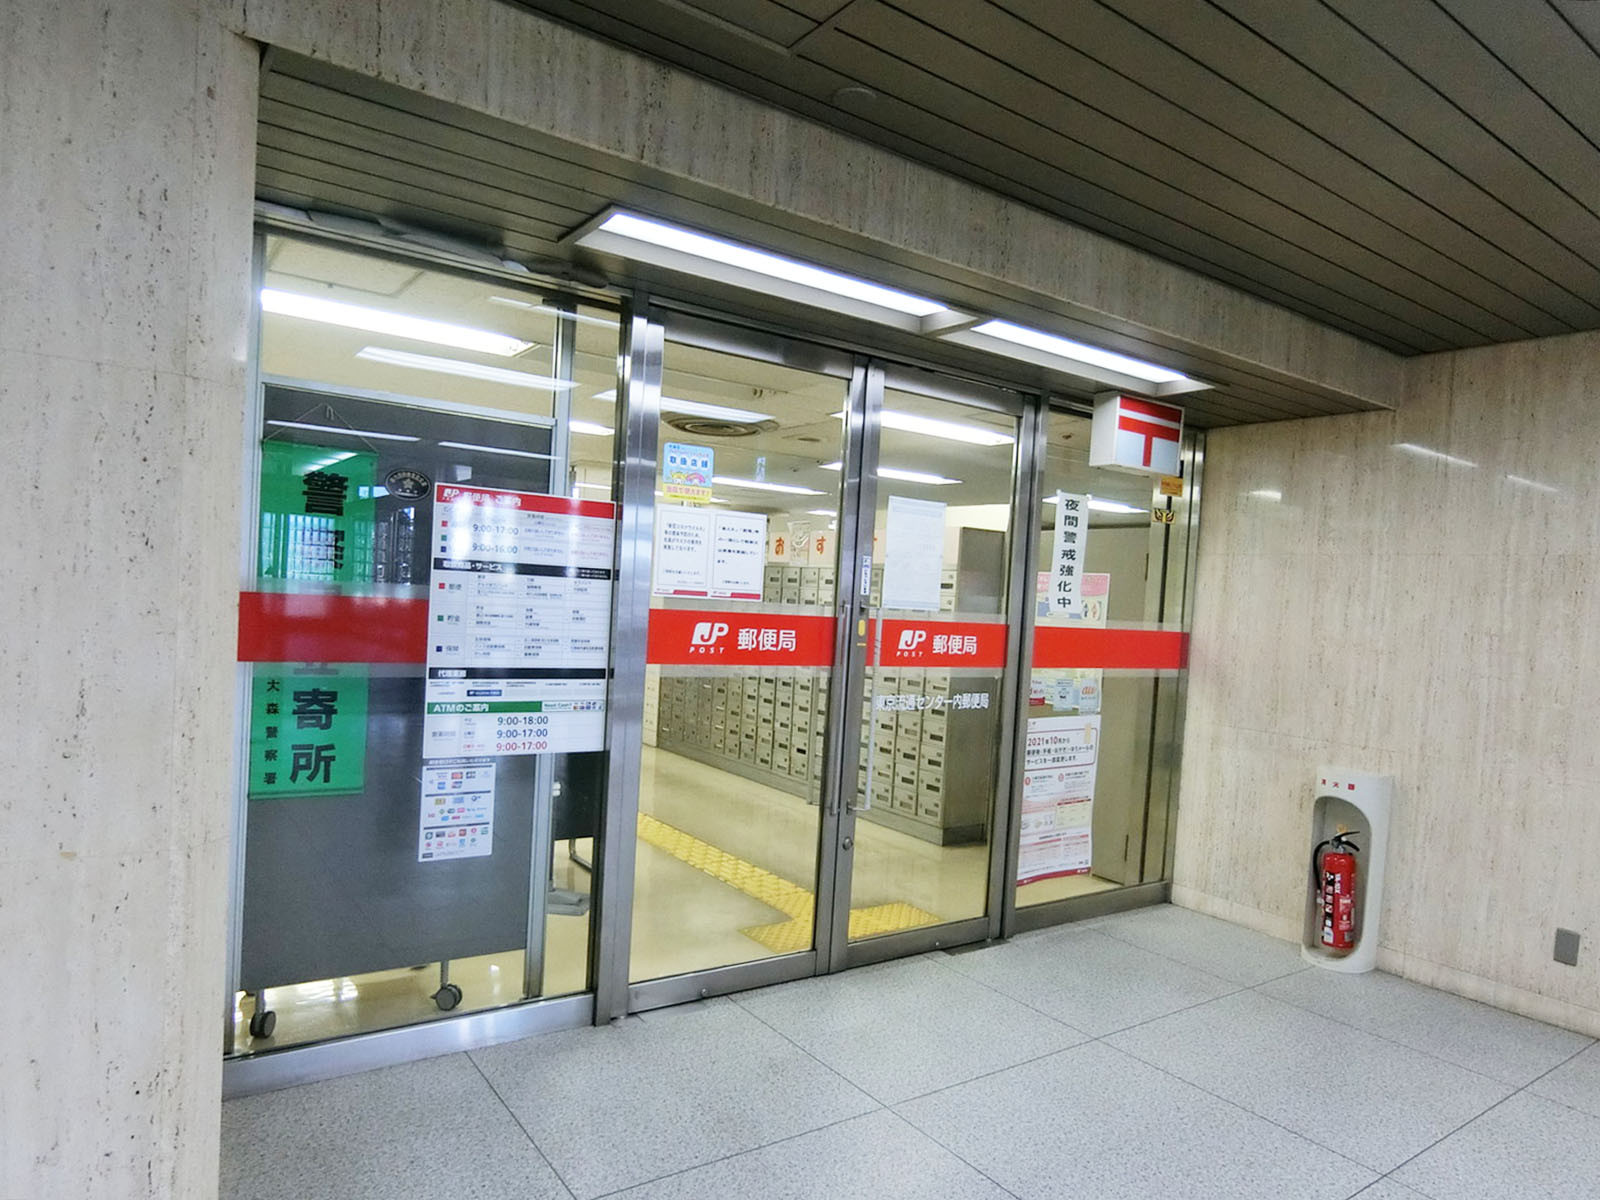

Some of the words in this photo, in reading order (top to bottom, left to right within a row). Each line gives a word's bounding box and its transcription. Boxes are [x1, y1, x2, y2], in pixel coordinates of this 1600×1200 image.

[1057, 499, 1080, 608] 夜間警戒強化中
[737, 628, 796, 652] 郵便局
[932, 634, 978, 656] 郵便局
[689, 646, 725, 654] POST
[497, 715, 549, 726] 9:00-18:00
[263, 679, 280, 785] 大森警察署
[496, 728, 548, 739] 9:00-17:00
[496, 741, 548, 752] 9:00-17:00
